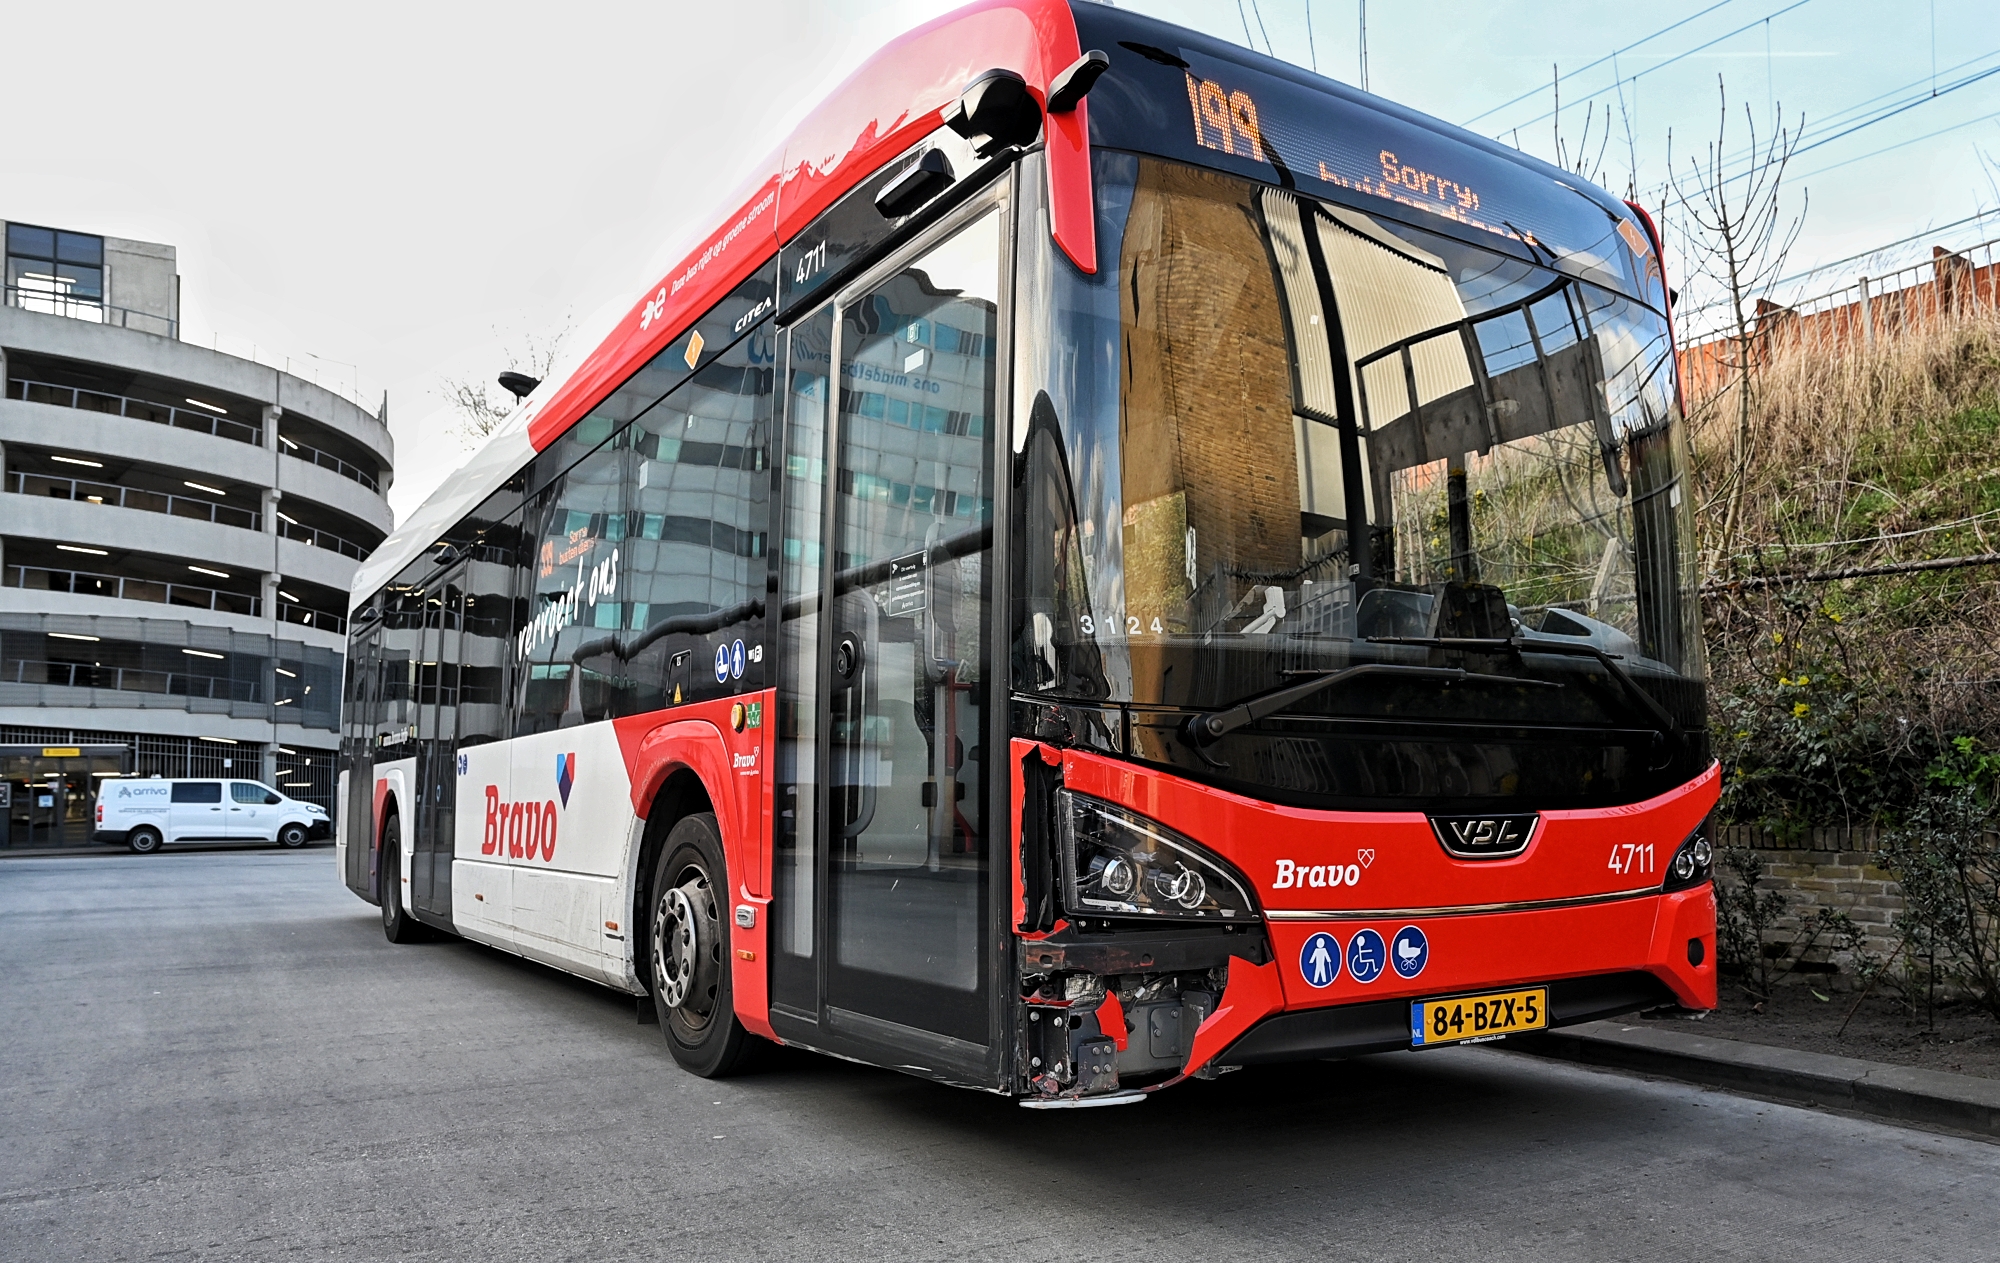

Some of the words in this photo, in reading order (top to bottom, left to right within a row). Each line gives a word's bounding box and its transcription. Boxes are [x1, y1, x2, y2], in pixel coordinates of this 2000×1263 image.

[1185, 72, 1263, 163] 199
[1380, 150, 1480, 211] Sorry,
[685, 266, 699, 282] bus
[698, 246, 713, 271] rijdt
[712, 240, 723, 257] op
[722, 216, 747, 251] groene
[747, 190, 775, 225] stroom
[795, 240, 826, 284] 4711
[734, 296, 772, 333] CITEA
[518, 555, 585, 661] vervoert
[588, 548, 619, 607] ons
[733, 752, 755, 768] Bravo
[482, 784, 557, 862] Bravo
[1449, 820, 1519, 846] VDL
[1272, 859, 1360, 889] Bravo
[1608, 843, 1655, 876] 4711
[1412, 1028, 1423, 1039] NL
[1433, 995, 1538, 1036] 84-BZX-5
